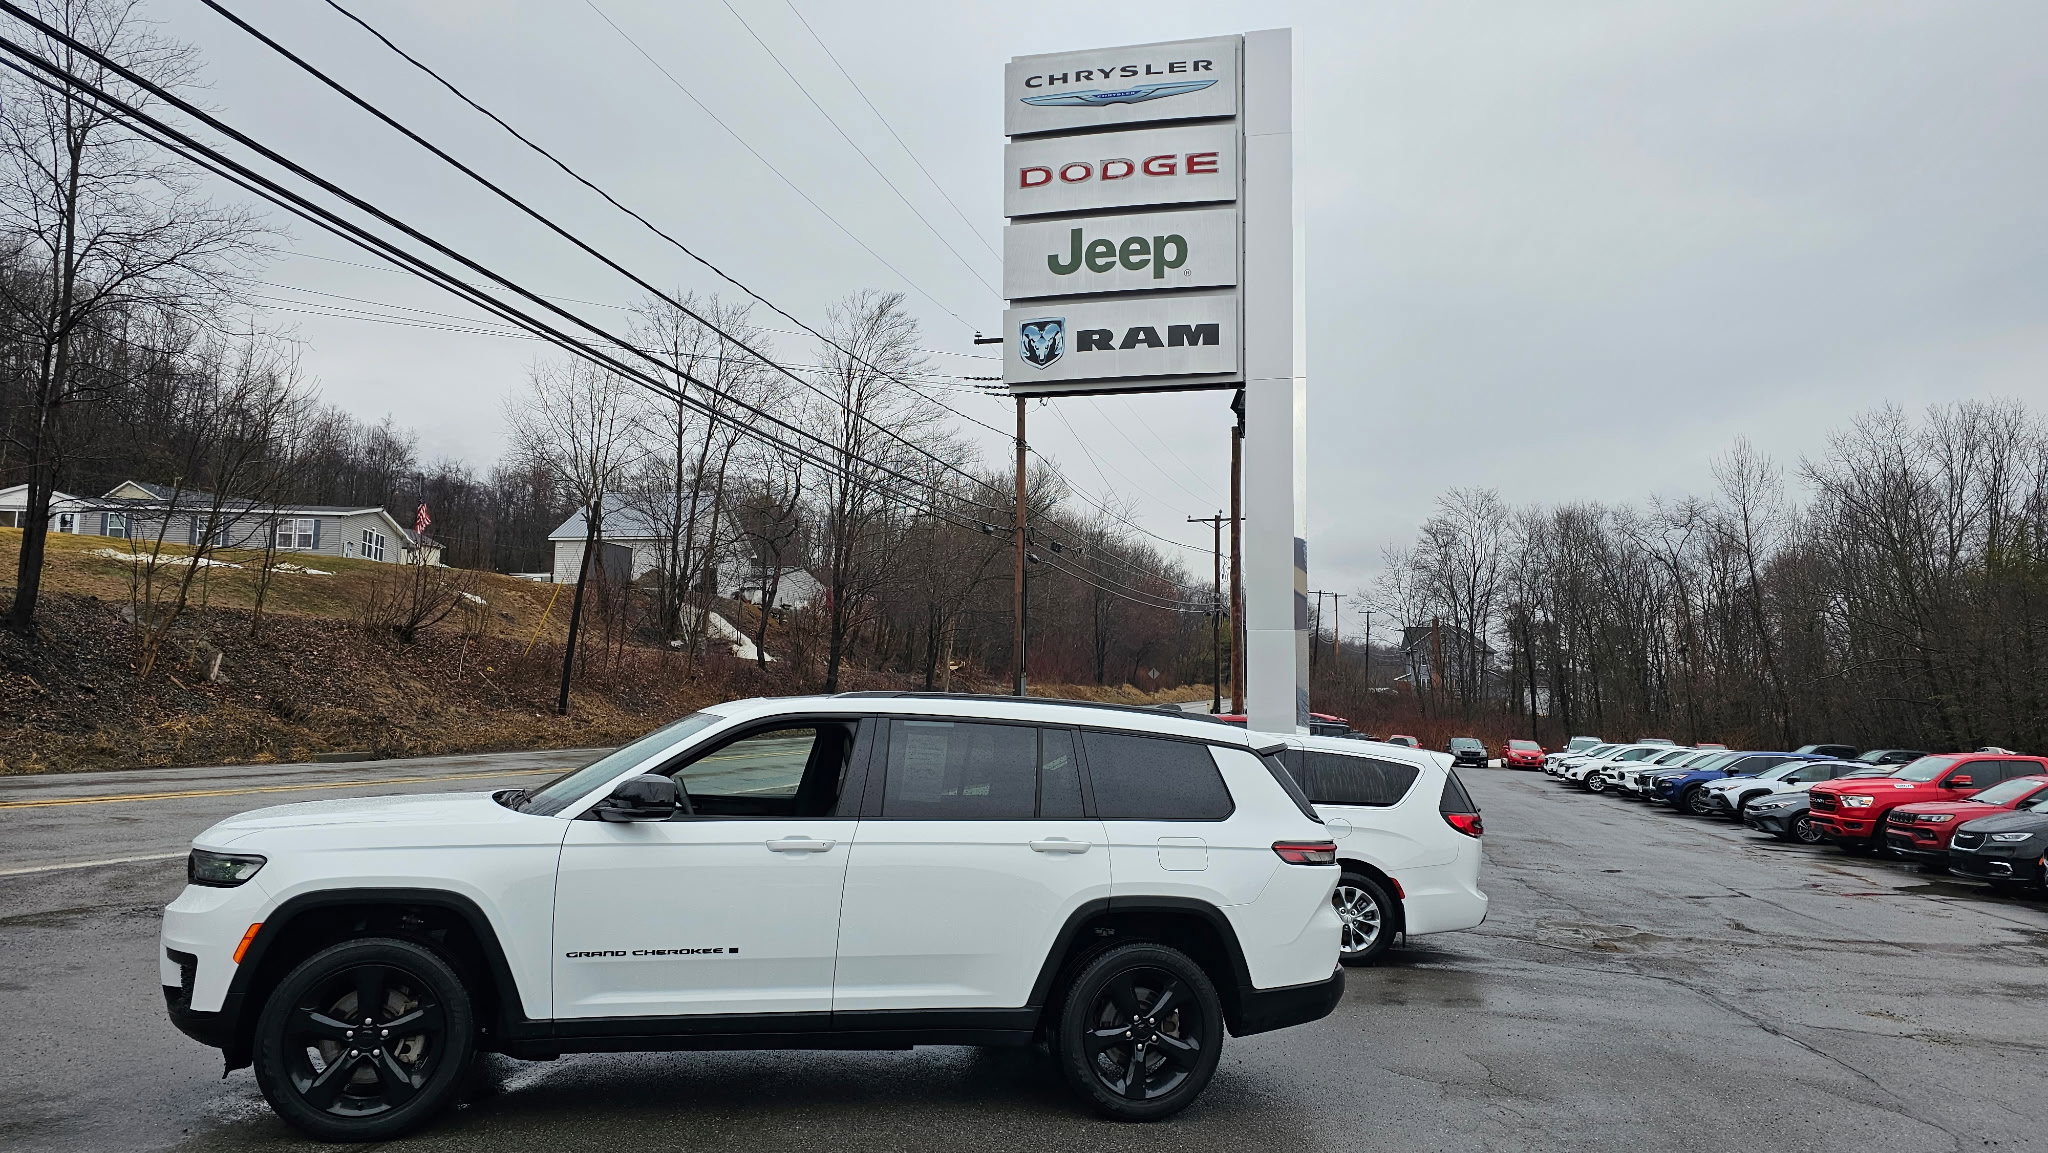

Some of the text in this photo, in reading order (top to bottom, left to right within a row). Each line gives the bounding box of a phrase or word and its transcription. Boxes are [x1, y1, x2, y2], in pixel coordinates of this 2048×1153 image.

[1024, 59, 1214, 88] CHRYSLER
[1019, 152, 1220, 189] DODGE
[1047, 228, 1189, 279] Jeep
[1076, 323, 1220, 353] RAM
[566, 947, 724, 958] GRAND CHEROKEE
